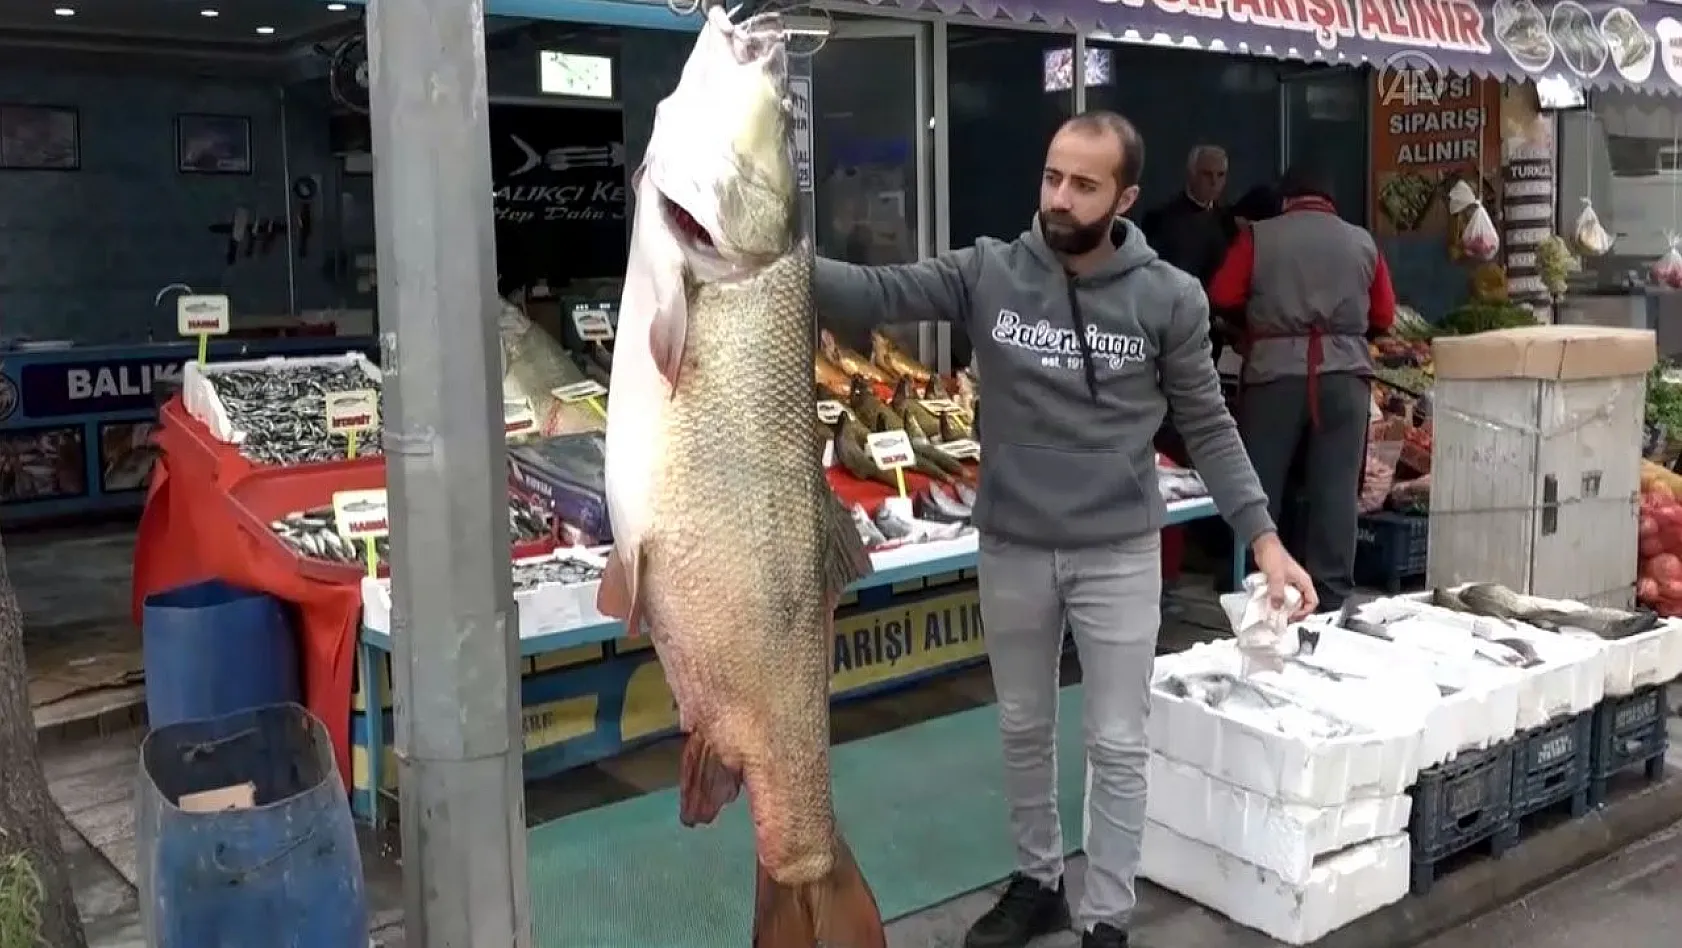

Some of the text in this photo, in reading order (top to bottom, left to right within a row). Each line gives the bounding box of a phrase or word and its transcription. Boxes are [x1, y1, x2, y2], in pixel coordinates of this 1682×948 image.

[1362, 0, 1484, 46] ALINIR
[1397, 138, 1479, 164] ALINIR
[494, 180, 625, 205] ALIKÇI KE
[992, 309, 1146, 370] Baleniaga
[833, 612, 913, 674] ARİŞİ
